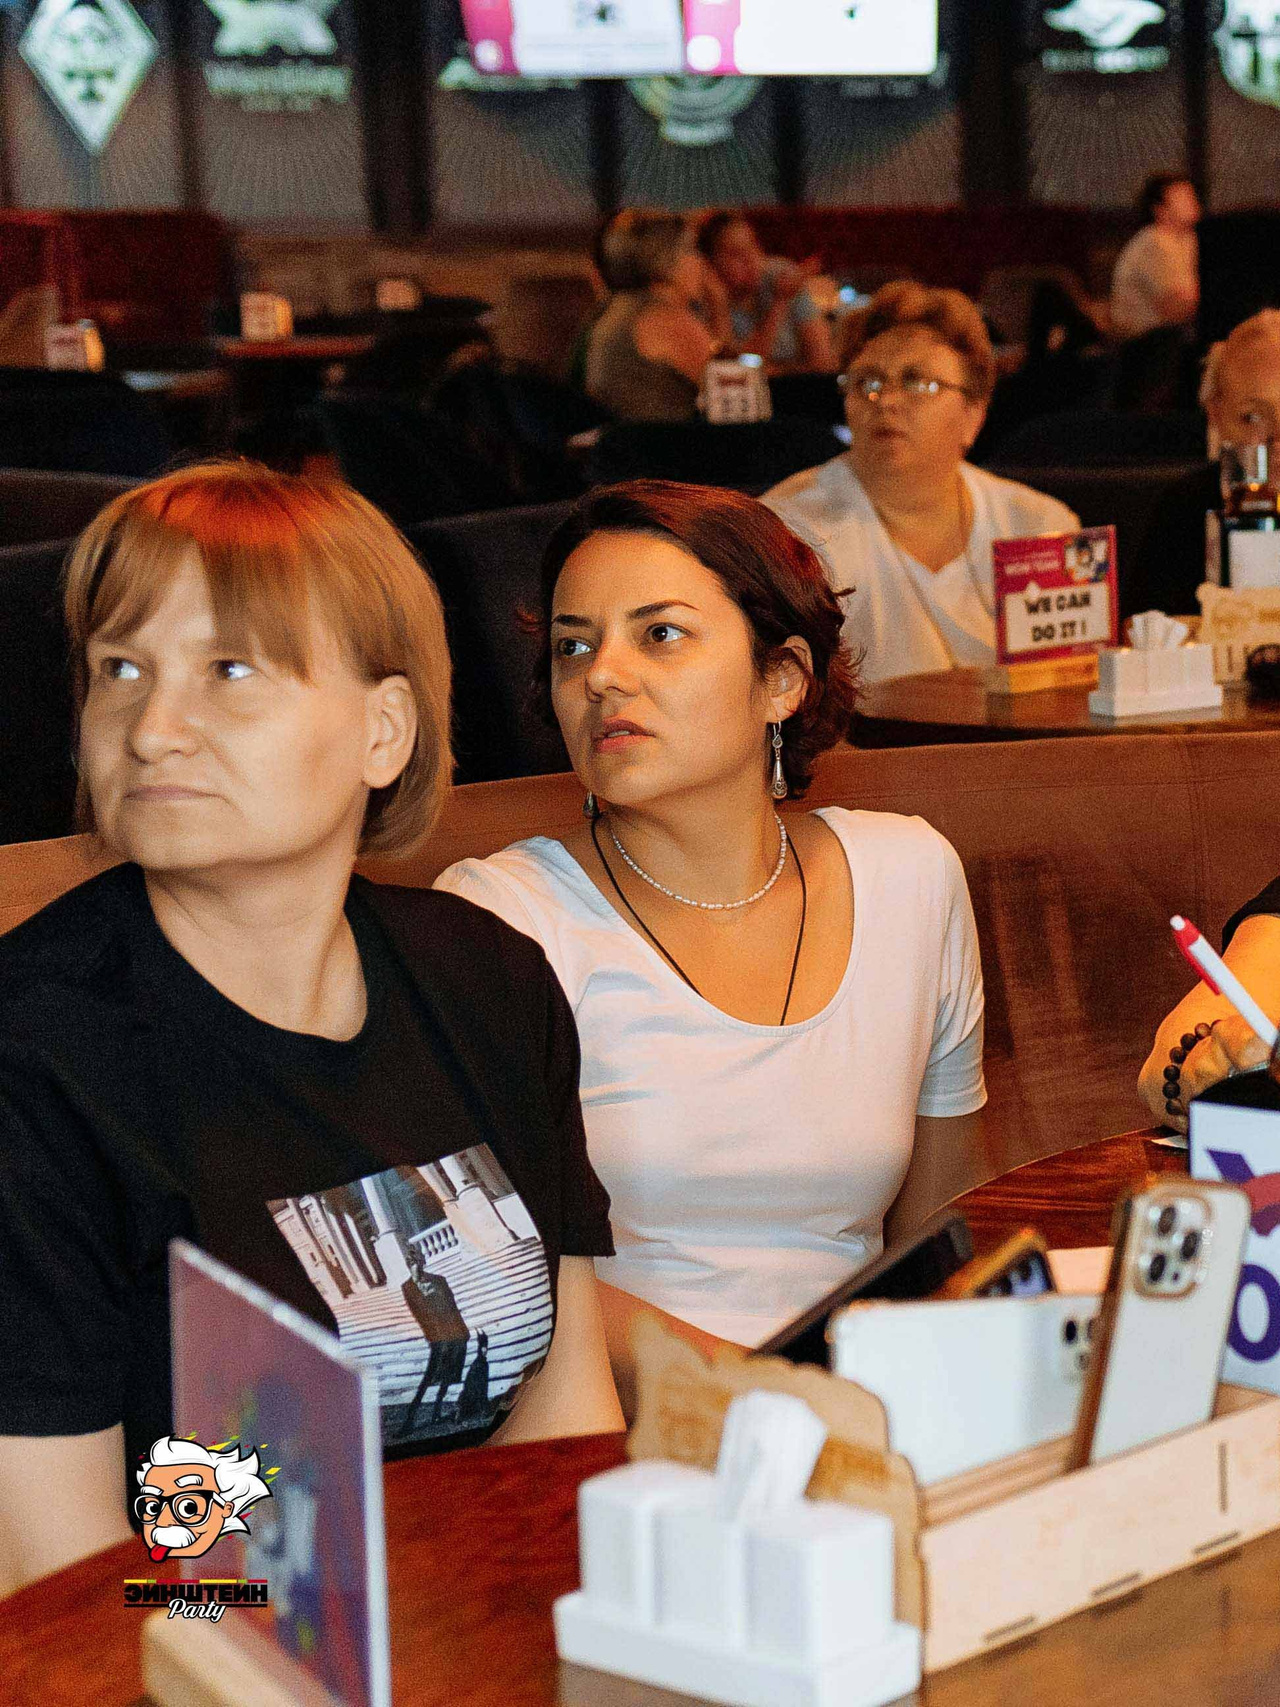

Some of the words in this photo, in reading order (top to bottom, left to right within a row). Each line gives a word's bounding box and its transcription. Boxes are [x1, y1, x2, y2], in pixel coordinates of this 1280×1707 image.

[1024, 595, 1051, 614] WE
[1056, 591, 1091, 612] CAN
[1032, 623, 1055, 642] DO
